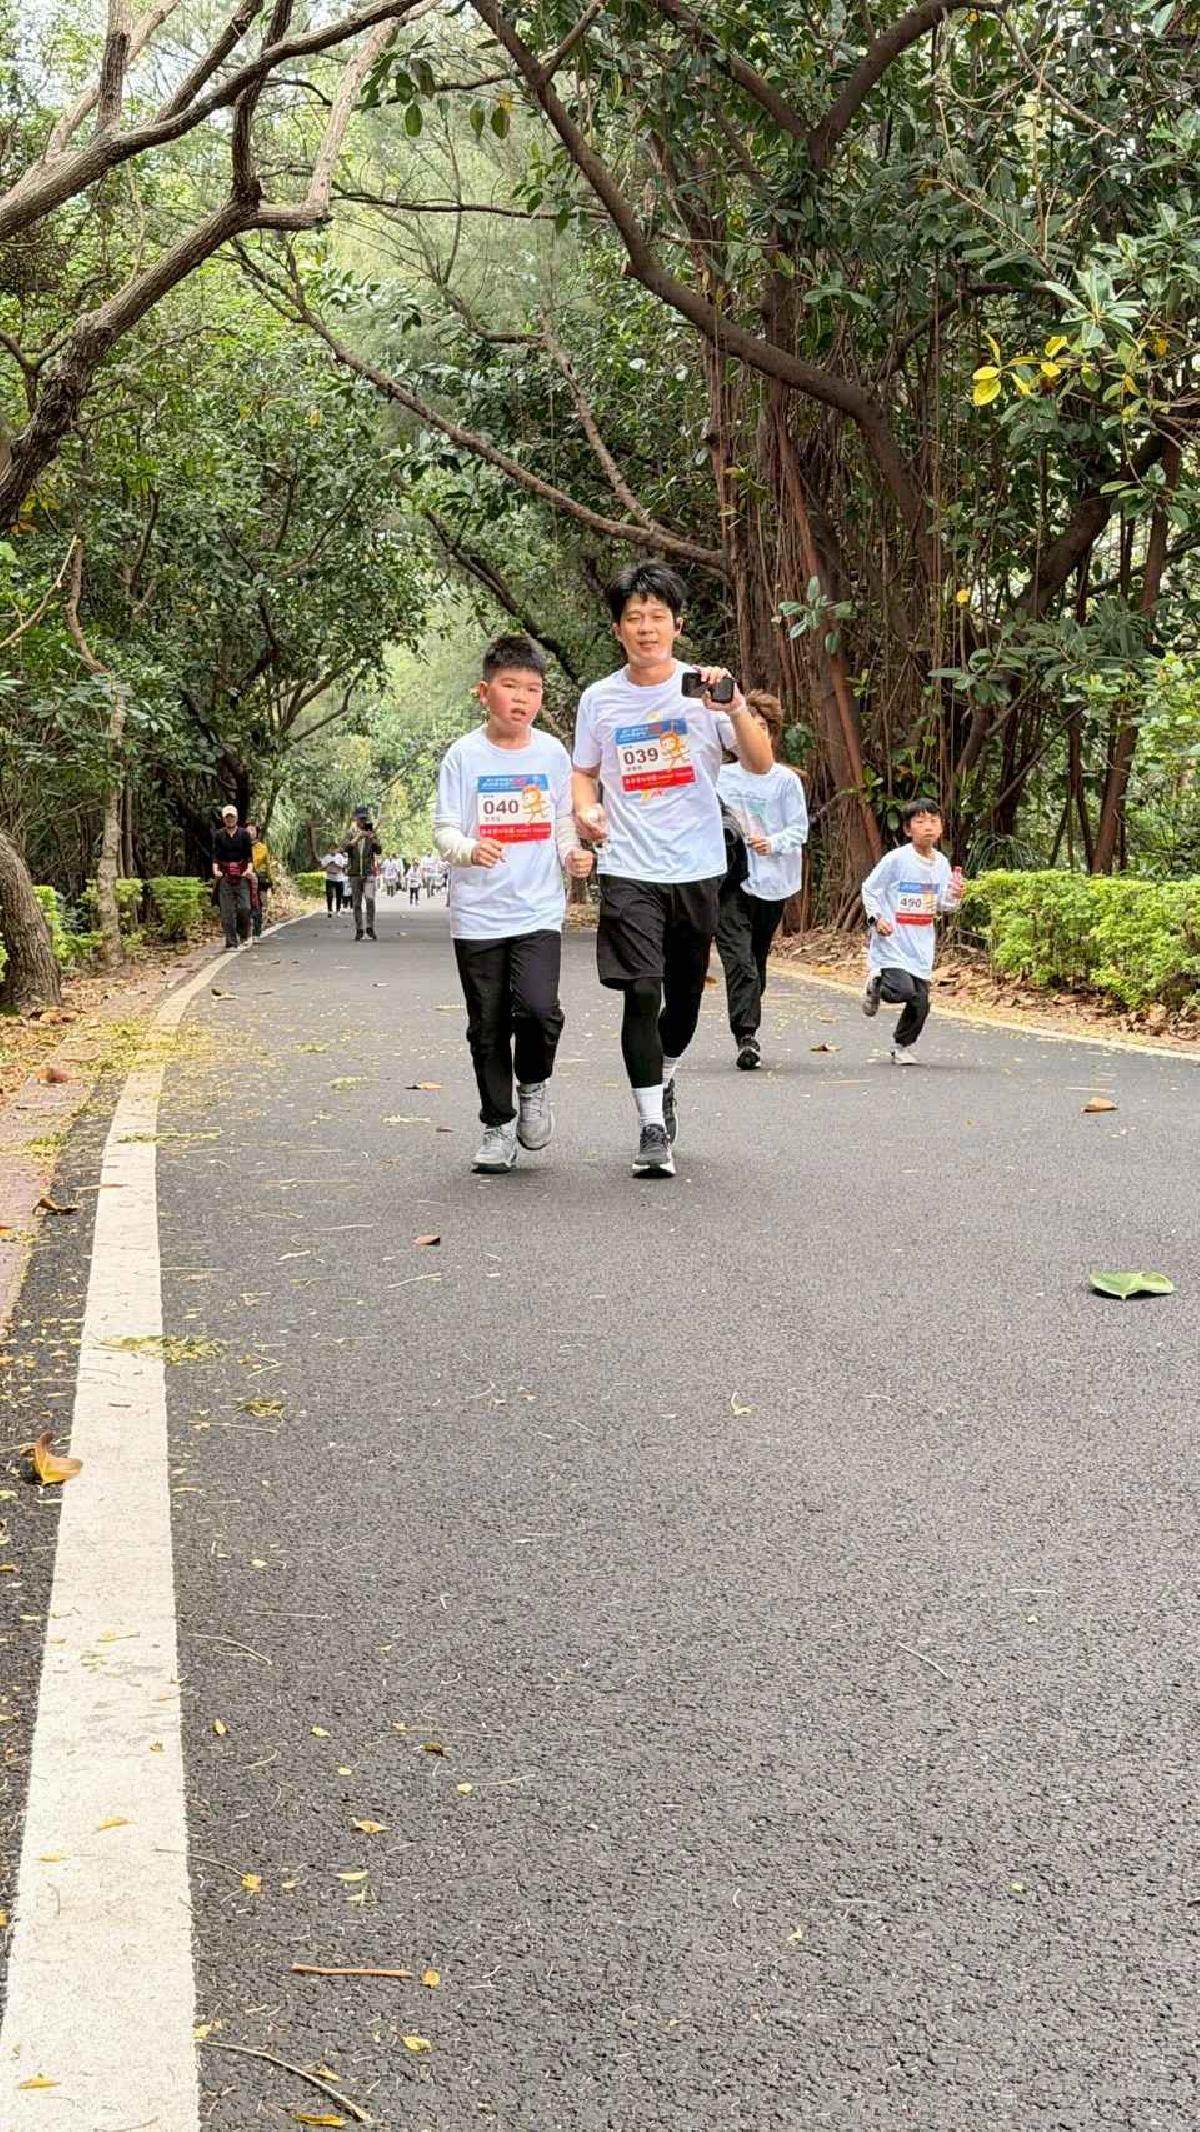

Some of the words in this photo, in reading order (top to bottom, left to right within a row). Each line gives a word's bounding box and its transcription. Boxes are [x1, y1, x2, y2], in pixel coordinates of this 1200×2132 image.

[624, 748, 659, 765] 039
[484, 800, 519, 814] 040
[900, 897, 922, 908] 490
